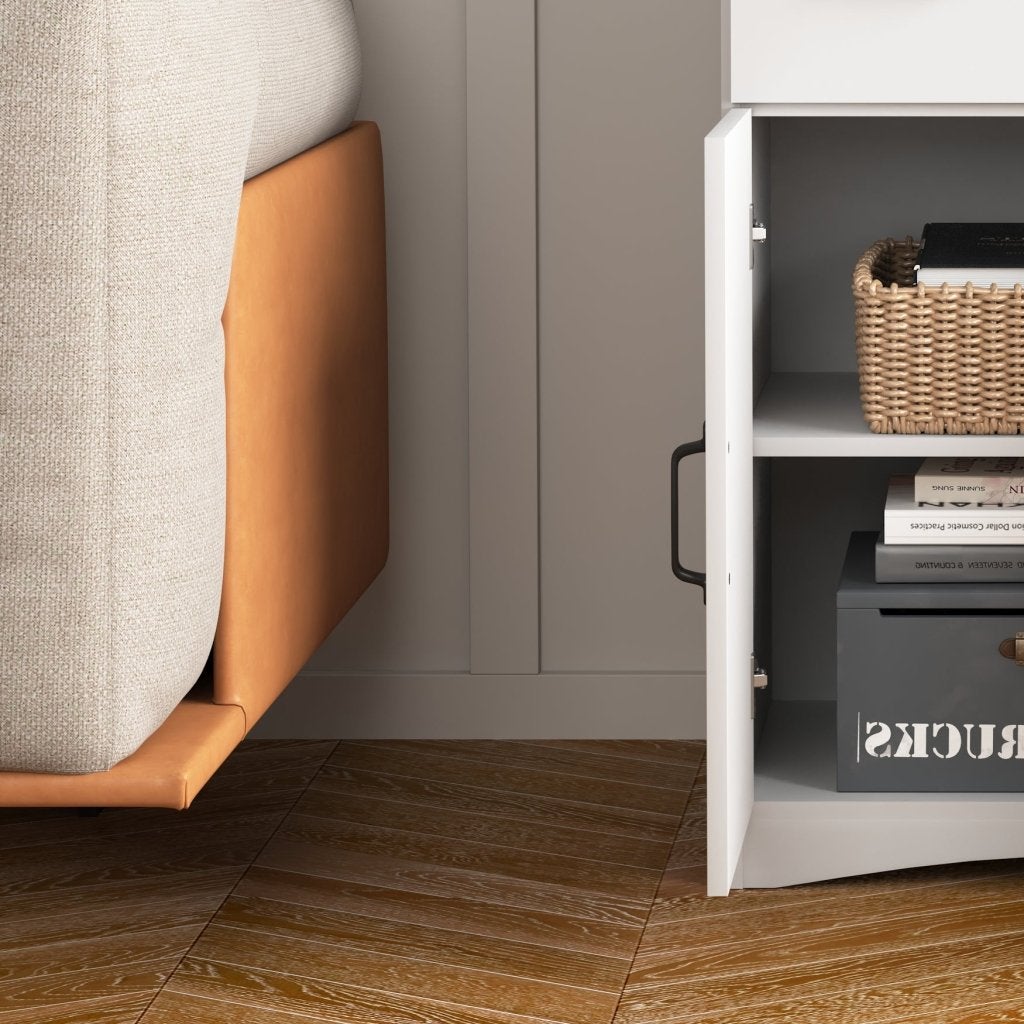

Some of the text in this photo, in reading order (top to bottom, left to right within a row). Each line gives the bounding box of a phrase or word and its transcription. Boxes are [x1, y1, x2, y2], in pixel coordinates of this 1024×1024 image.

[910, 523, 945, 531] Practices
[947, 523, 984, 531] Cosmetic
[986, 523, 1010, 531] Dollar
